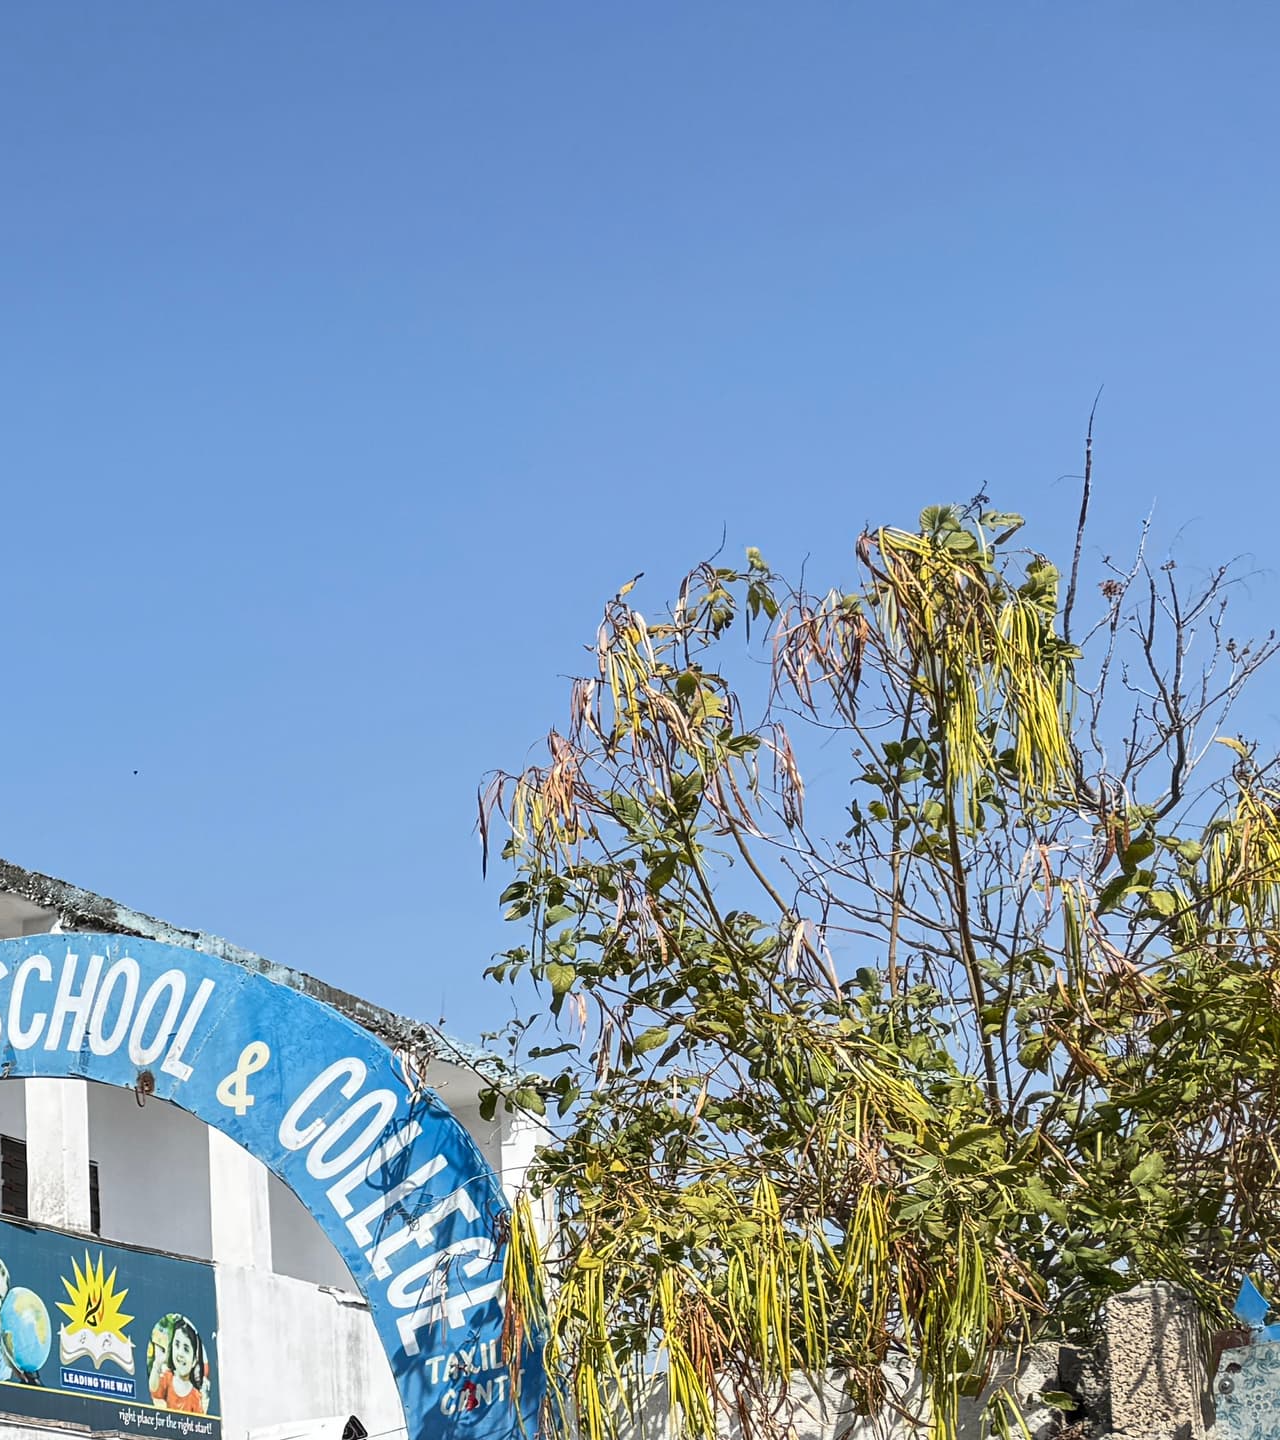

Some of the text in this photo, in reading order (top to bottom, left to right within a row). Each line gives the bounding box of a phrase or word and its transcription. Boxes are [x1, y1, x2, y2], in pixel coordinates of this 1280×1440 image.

[216, 1041, 270, 1115] &
[278, 1057, 507, 1356] COLLEGE
[425, 1338, 506, 1385] TAXIL
[63, 1373, 134, 1394] LEADING THE WAY
[118, 1408, 136, 1425] right
[137, 1411, 154, 1428] place
[155, 1411, 166, 1430] for
[166, 1414, 177, 1429] the
[177, 1418, 194, 1434] right
